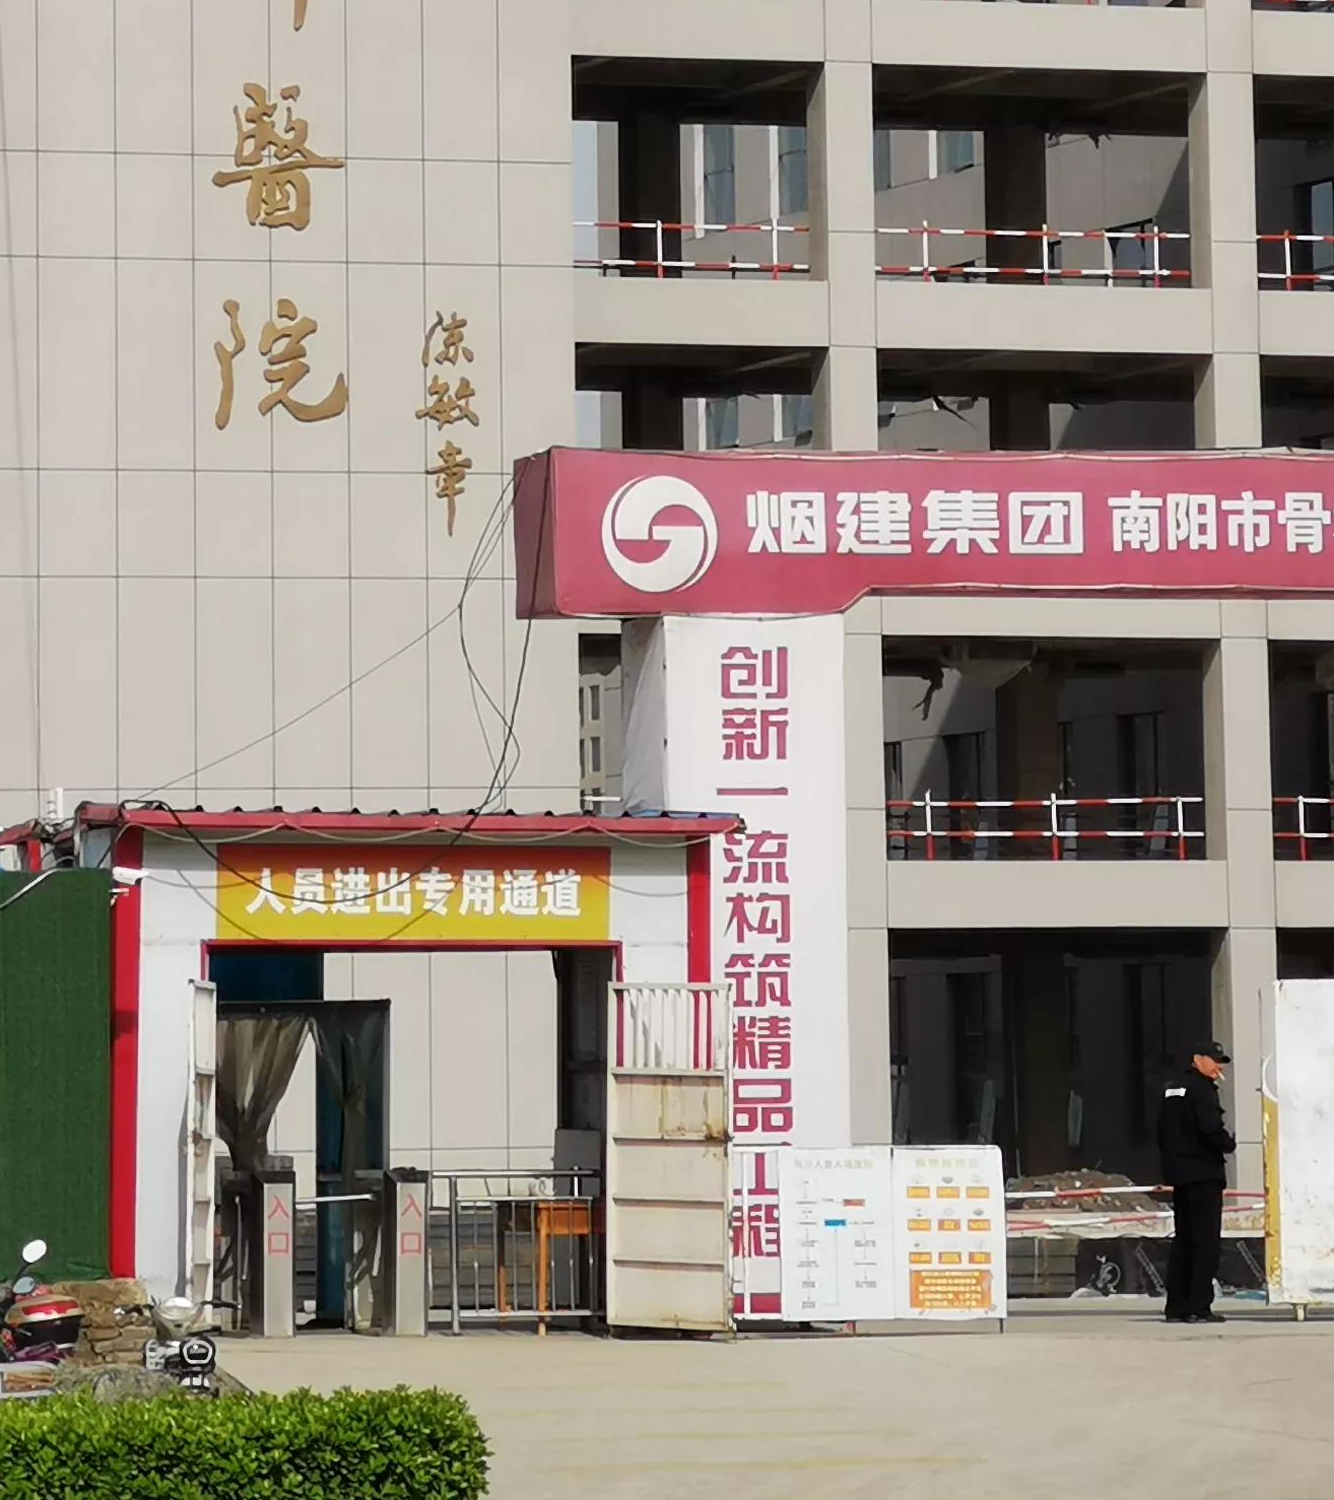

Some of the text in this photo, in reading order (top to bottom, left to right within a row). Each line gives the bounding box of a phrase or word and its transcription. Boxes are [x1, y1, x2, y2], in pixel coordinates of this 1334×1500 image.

[747, 490, 1084, 554] 烟建集团
[245, 867, 582, 916] 人员进出专用通道
[268, 1195, 290, 1255] 入口
[401, 1193, 422, 1254] 入口
